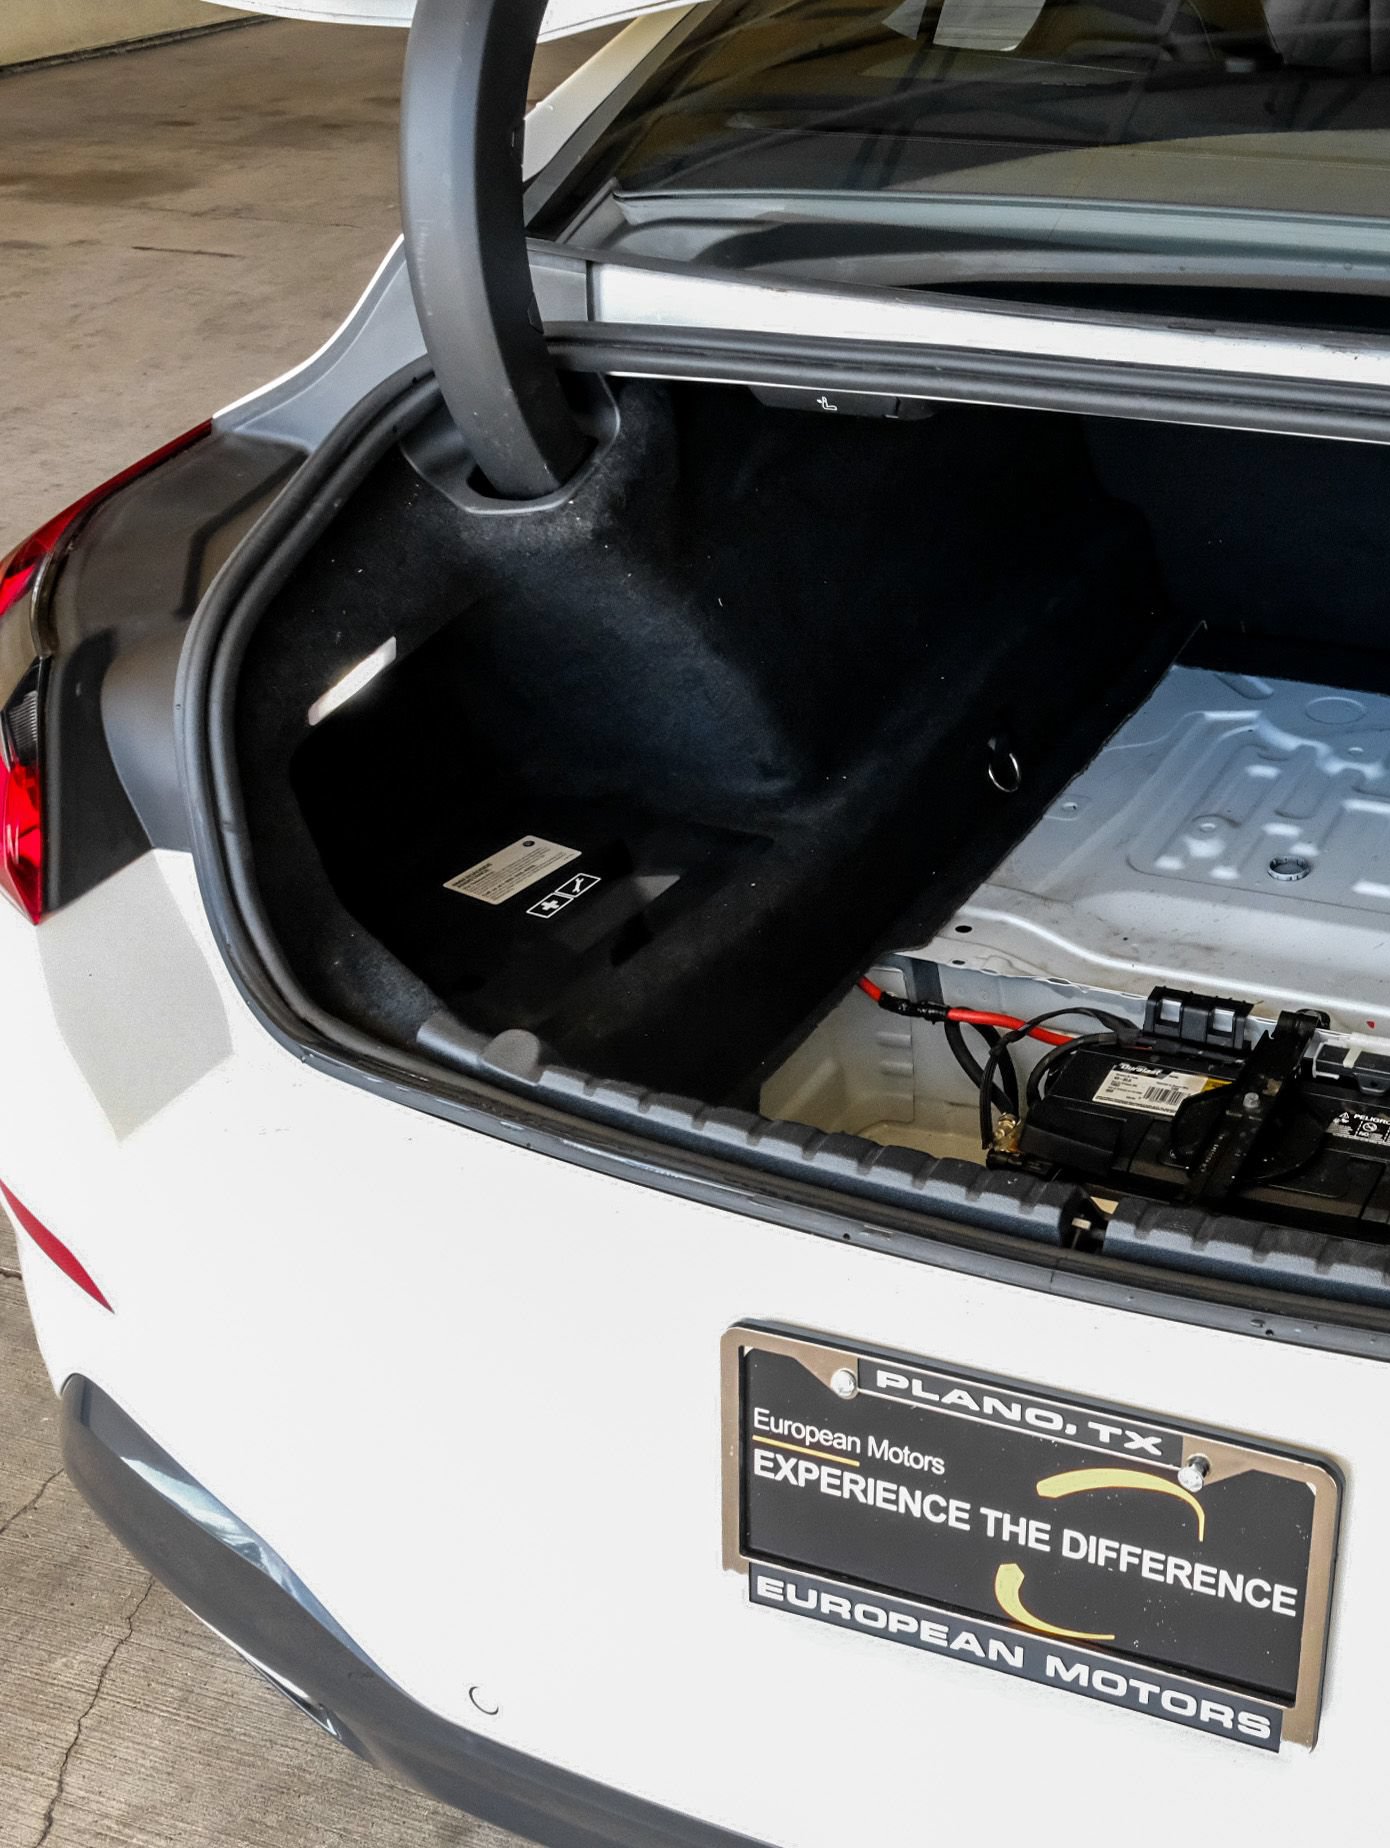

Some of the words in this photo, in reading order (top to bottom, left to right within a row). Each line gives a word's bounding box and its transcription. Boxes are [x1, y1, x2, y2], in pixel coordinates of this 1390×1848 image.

[1119, 1062, 1164, 1077] Duralast
[753, 1406, 861, 1454] European
[867, 1435, 946, 1475] Motors
[876, 1369, 1077, 1436] PLANO,
[1087, 1421, 1163, 1456] TX
[753, 1448, 971, 1531] EXPERIENCE
[979, 1506, 1052, 1553] THE
[1061, 1528, 1298, 1617] DIFFERENCE
[756, 1575, 1024, 1669] EUROPEAN
[1045, 1654, 1271, 1740] MOTORS
